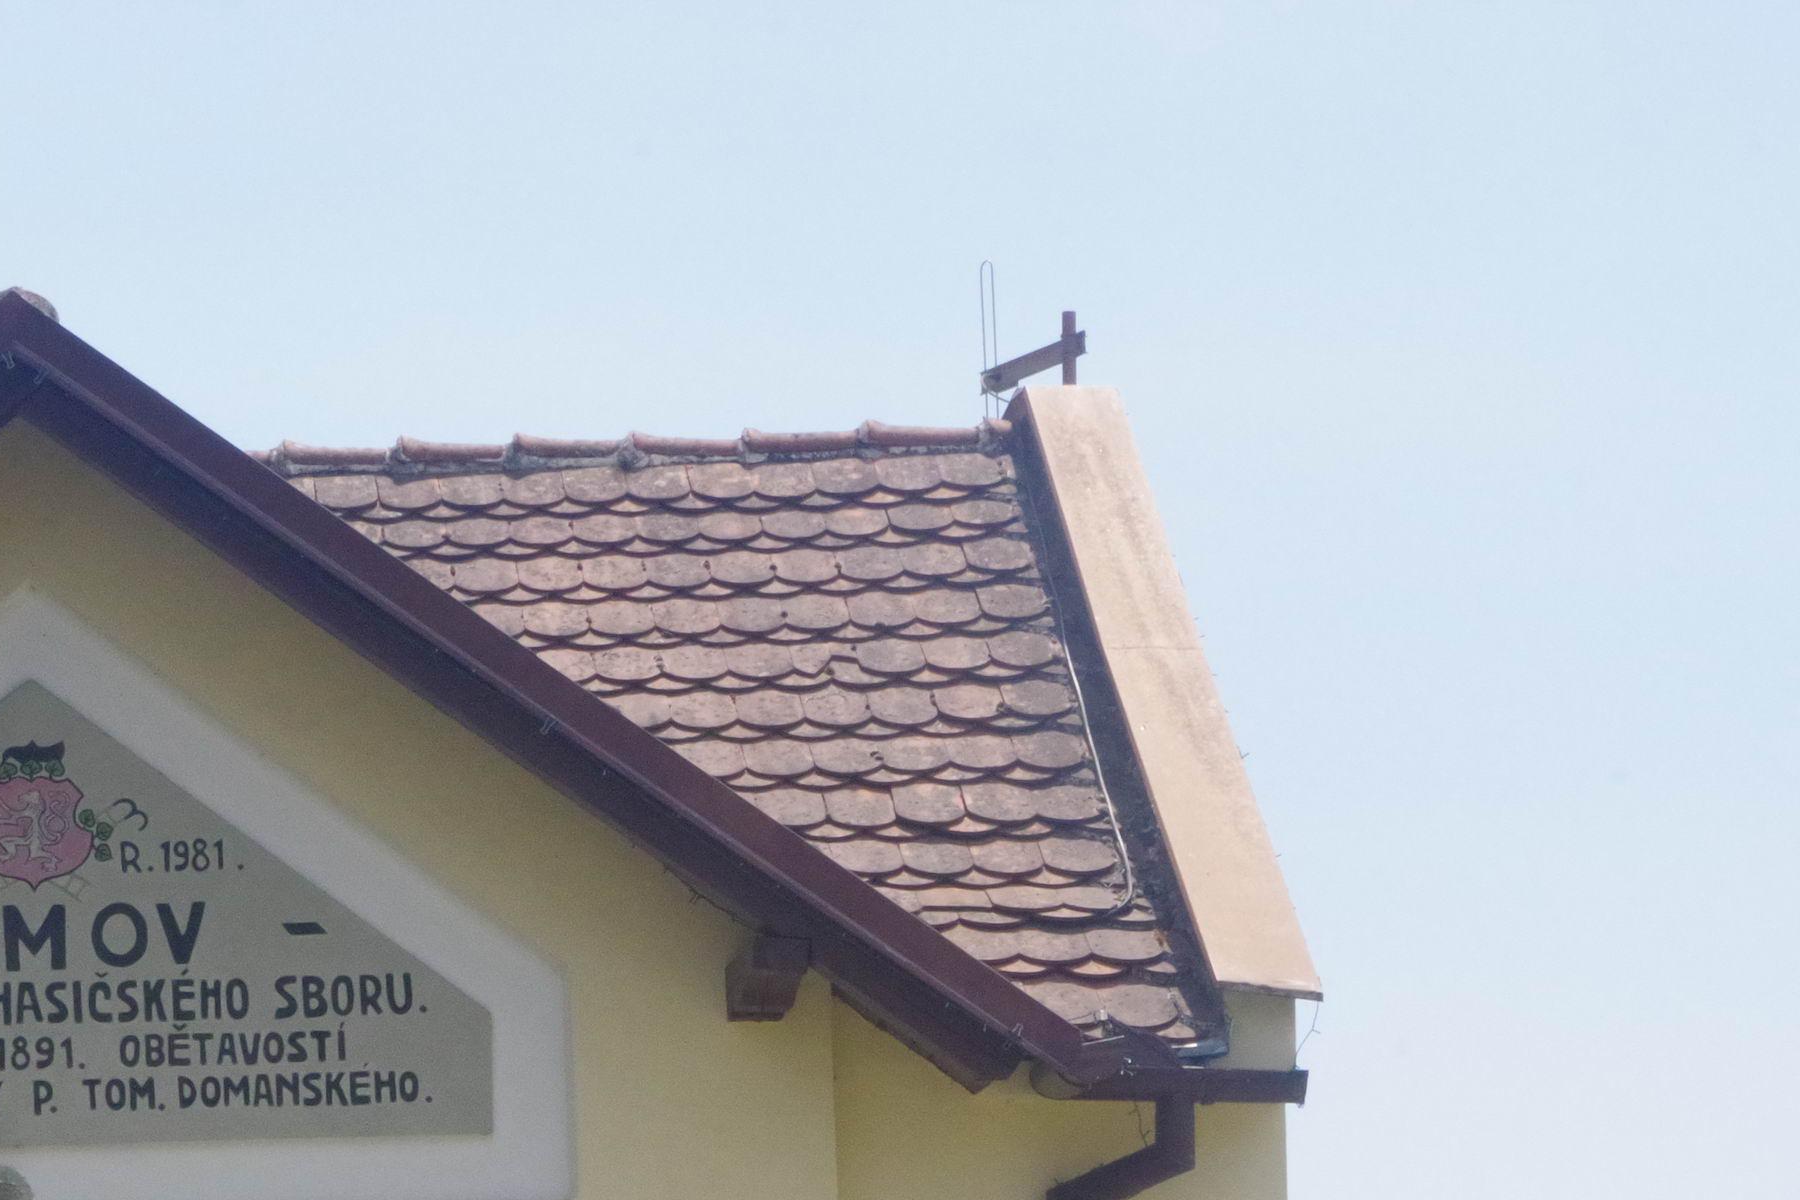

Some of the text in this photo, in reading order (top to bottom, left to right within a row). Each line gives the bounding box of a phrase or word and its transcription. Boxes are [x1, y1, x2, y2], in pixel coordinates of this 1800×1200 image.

[274, 971, 428, 1020] SBORU.
[119, 1022, 347, 1068] OBĚTAVOSTÍ
[32, 1079, 59, 1116] P.
[81, 1076, 167, 1113] TOM.
[177, 1062, 434, 1110] DOMANSKÉHO.
